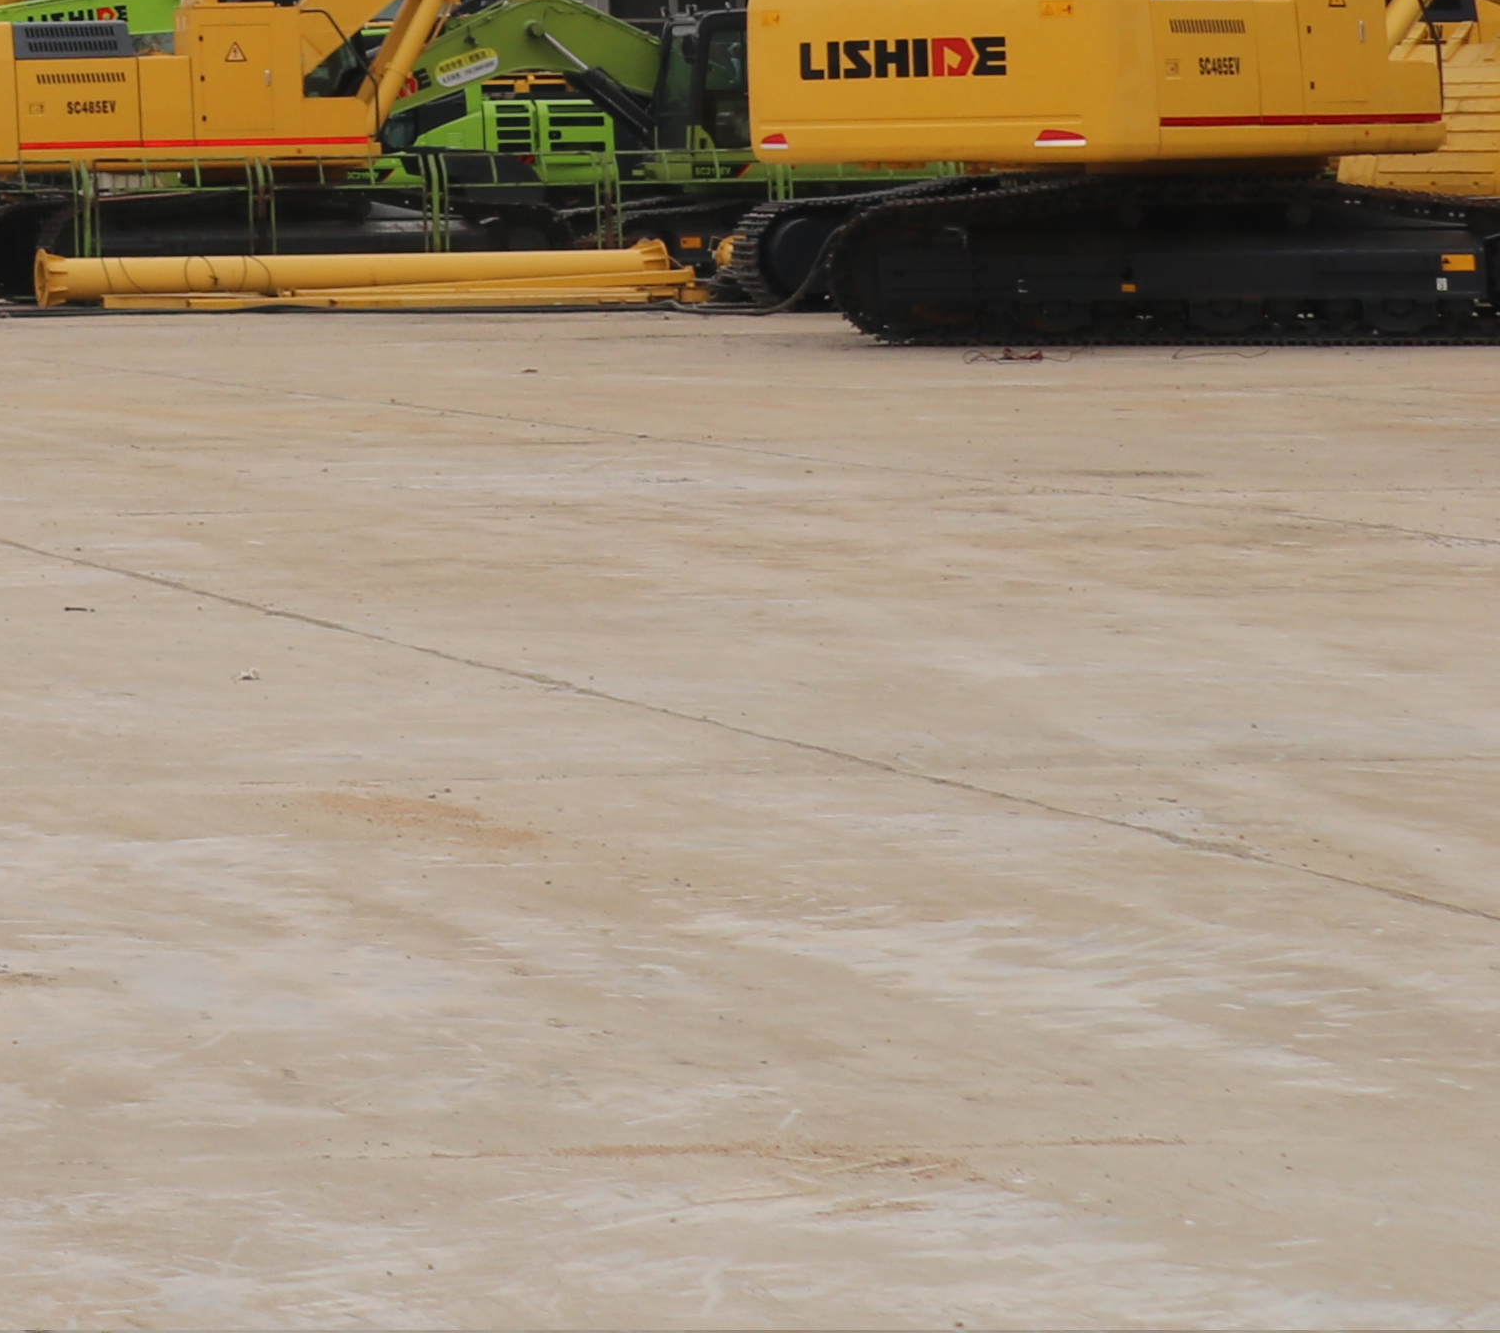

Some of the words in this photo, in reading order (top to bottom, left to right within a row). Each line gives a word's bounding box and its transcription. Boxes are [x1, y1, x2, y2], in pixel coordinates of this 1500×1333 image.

[799, 36, 1008, 81] LISHIDE
[1198, 57, 1241, 76] SC485EV
[66, 100, 117, 115] SC485EV
